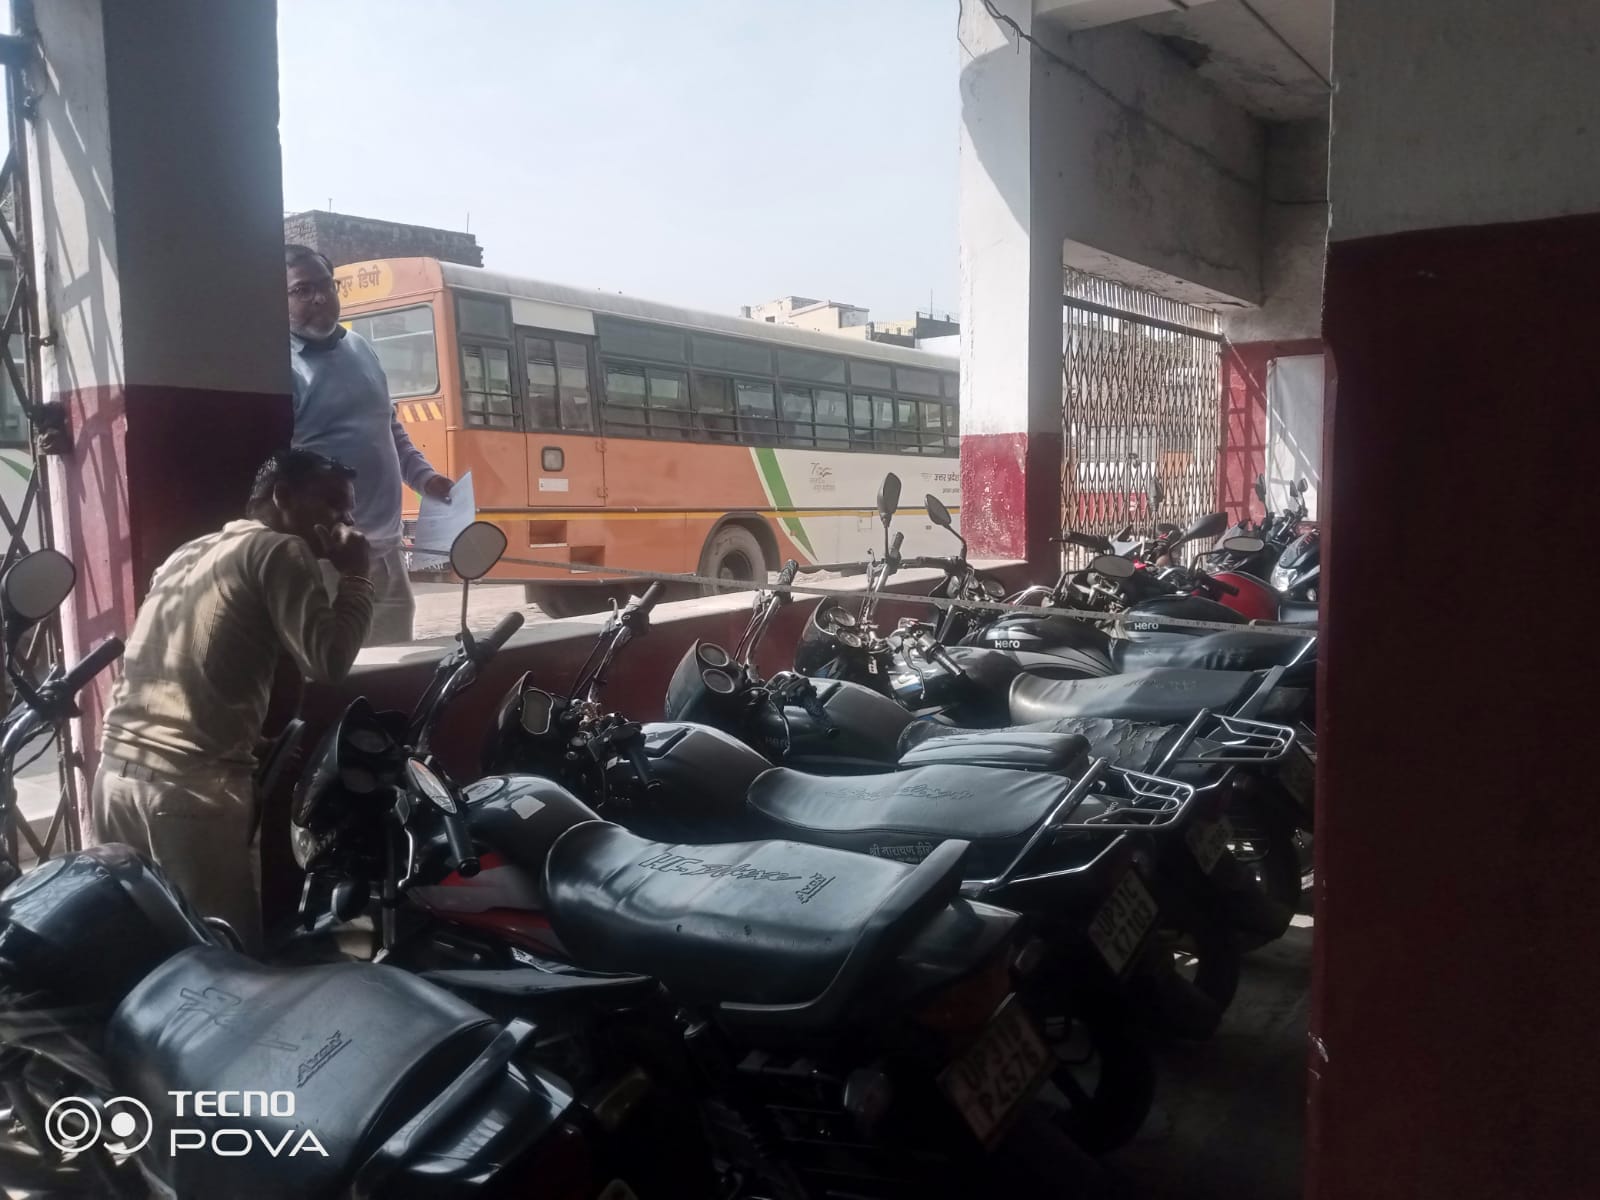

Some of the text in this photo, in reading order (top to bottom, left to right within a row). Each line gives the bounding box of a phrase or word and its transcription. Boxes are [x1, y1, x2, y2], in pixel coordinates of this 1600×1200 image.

[335, 275, 354, 299] पुर
[1134, 622, 1159, 632] Hero
[994, 639, 1021, 649] Hero
